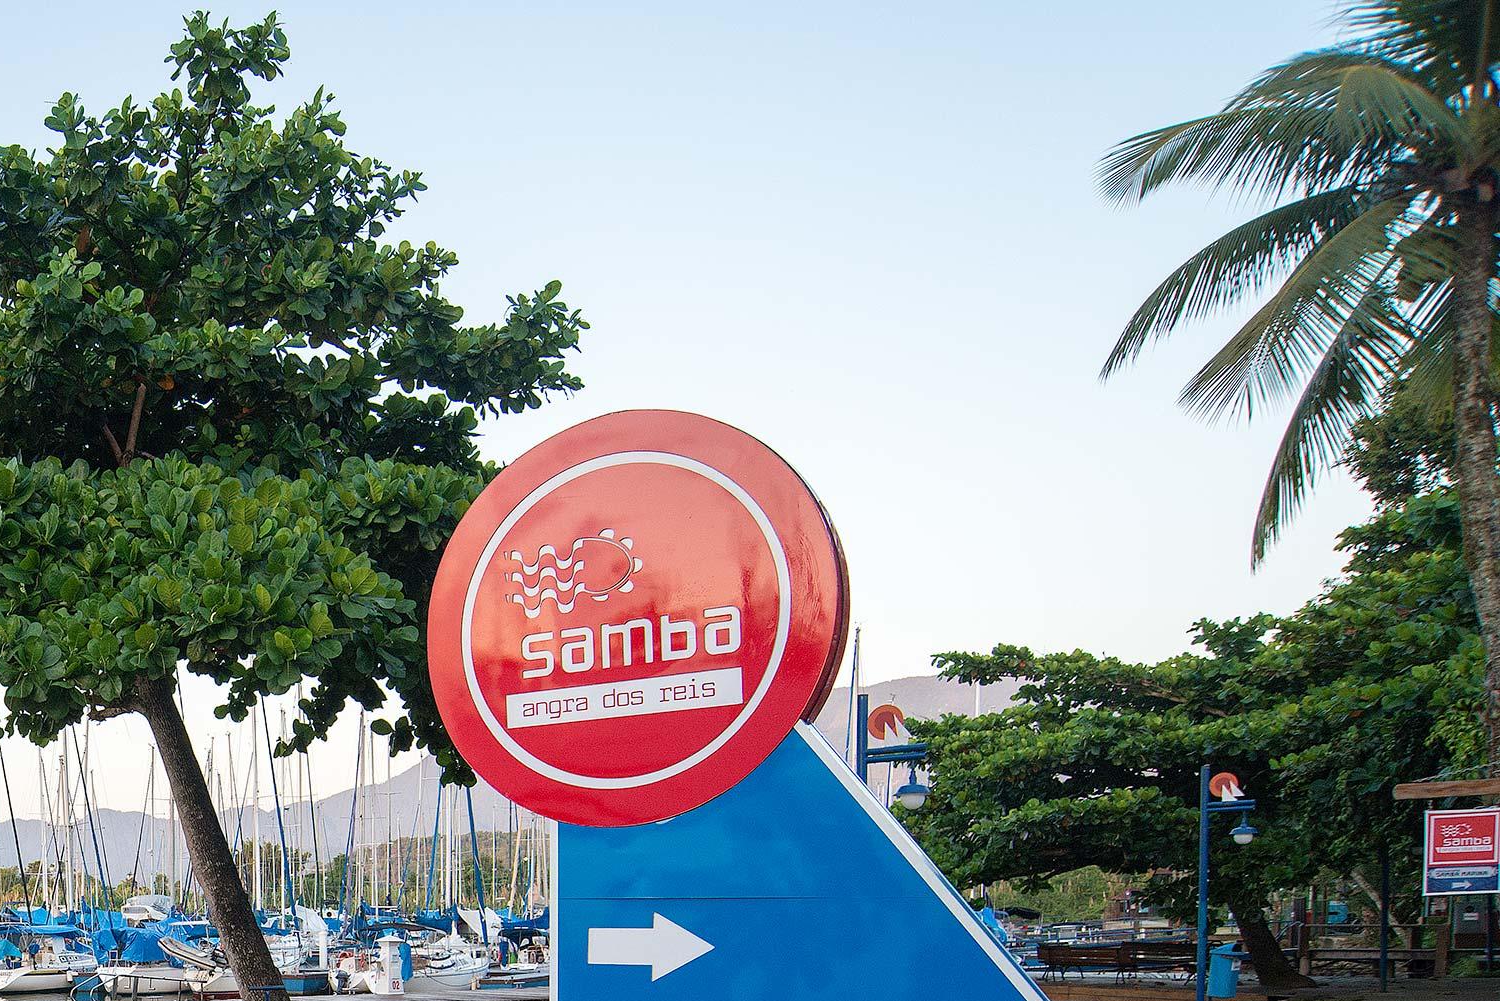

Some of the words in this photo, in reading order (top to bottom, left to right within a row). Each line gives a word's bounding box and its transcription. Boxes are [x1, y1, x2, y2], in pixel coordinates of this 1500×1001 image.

[521, 606, 742, 679] samba
[523, 697, 588, 719] angra
[603, 689, 644, 708] dos
[660, 678, 716, 702] reis
[1443, 836, 1492, 847] samba
[392, 980, 400, 990] 02
